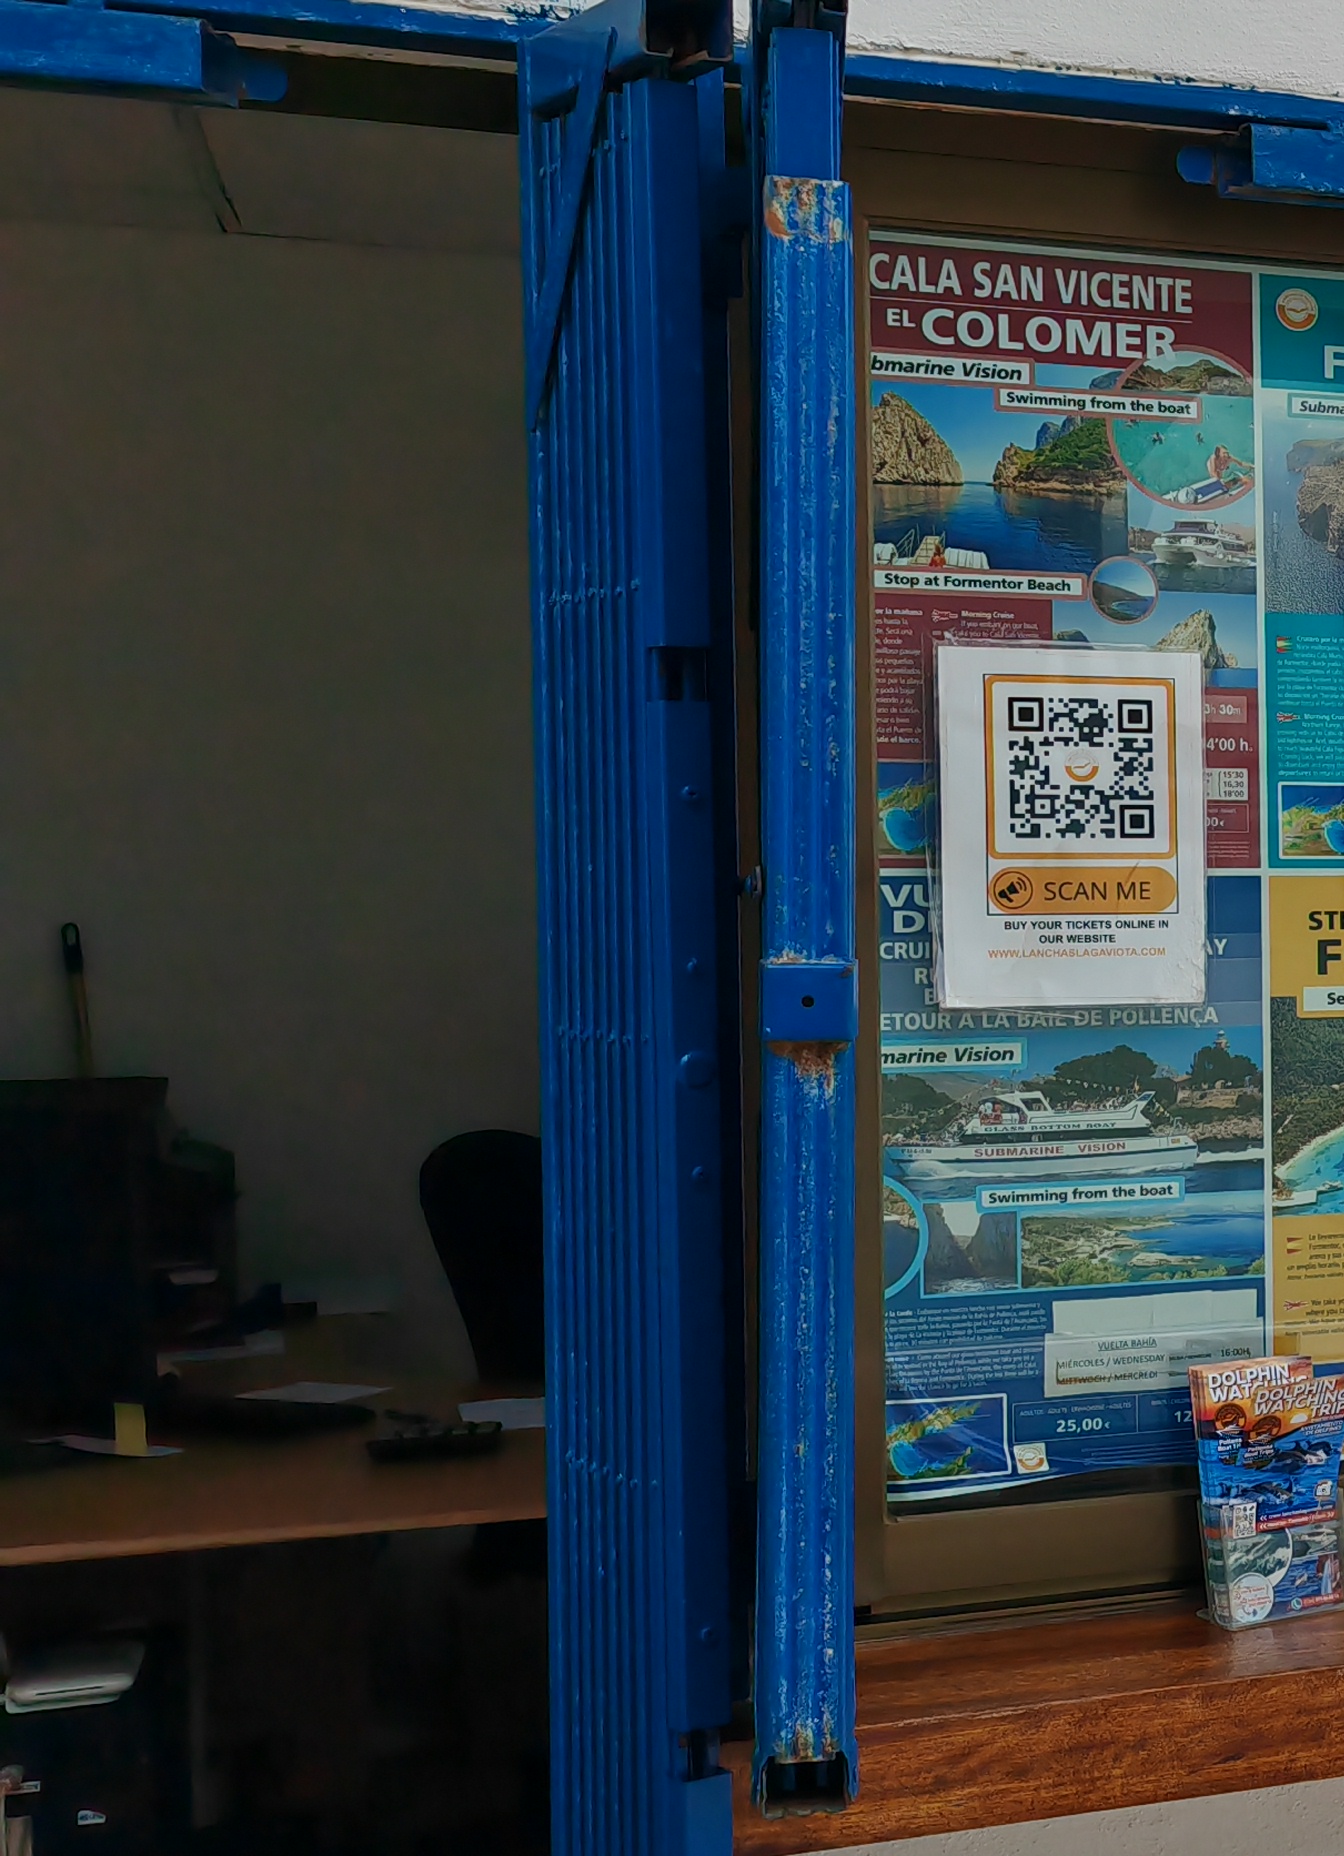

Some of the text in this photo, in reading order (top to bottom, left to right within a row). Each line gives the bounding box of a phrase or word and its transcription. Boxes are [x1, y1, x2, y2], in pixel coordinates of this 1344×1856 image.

[869, 253, 1193, 313] CALA SAN VICENTE
[886, 308, 1176, 359] EL COLOMER
[962, 357, 1022, 381] Vision
[1007, 391, 1192, 415] Swimming from the boat
[884, 573, 1071, 592] Stop at Formentor Beach
[961, 611, 1015, 619] Morning Cruise
[1044, 882, 1151, 900] SCAN ME
[1004, 920, 1169, 930] BUY YOUR TICKETS ONLINE IN
[1039, 934, 1116, 944] OUR WEBSITE
[989, 948, 1166, 959] WWW.LANCHASLAGAVIOTA.COM
[982, 1013, 1010, 1029] LA
[1074, 1010, 1102, 1026] DE
[1109, 1007, 1219, 1028] POLLENÇA
[954, 1047, 1014, 1063] Vision
[984, 1122, 1116, 1133] GLASS BOTTOM BOAT
[974, 1142, 1126, 1157] SUBMARINE VISION
[989, 1184, 1173, 1205] Swimming from the boat
[1098, 1341, 1129, 1351] VUELTA
[1113, 1354, 1165, 1365] WEDNESDAY
[1114, 1371, 1158, 1381] MERCREDI
[1208, 1364, 1289, 1389] DOLPHIN
[1258, 1379, 1337, 1403] DOLPHIN
